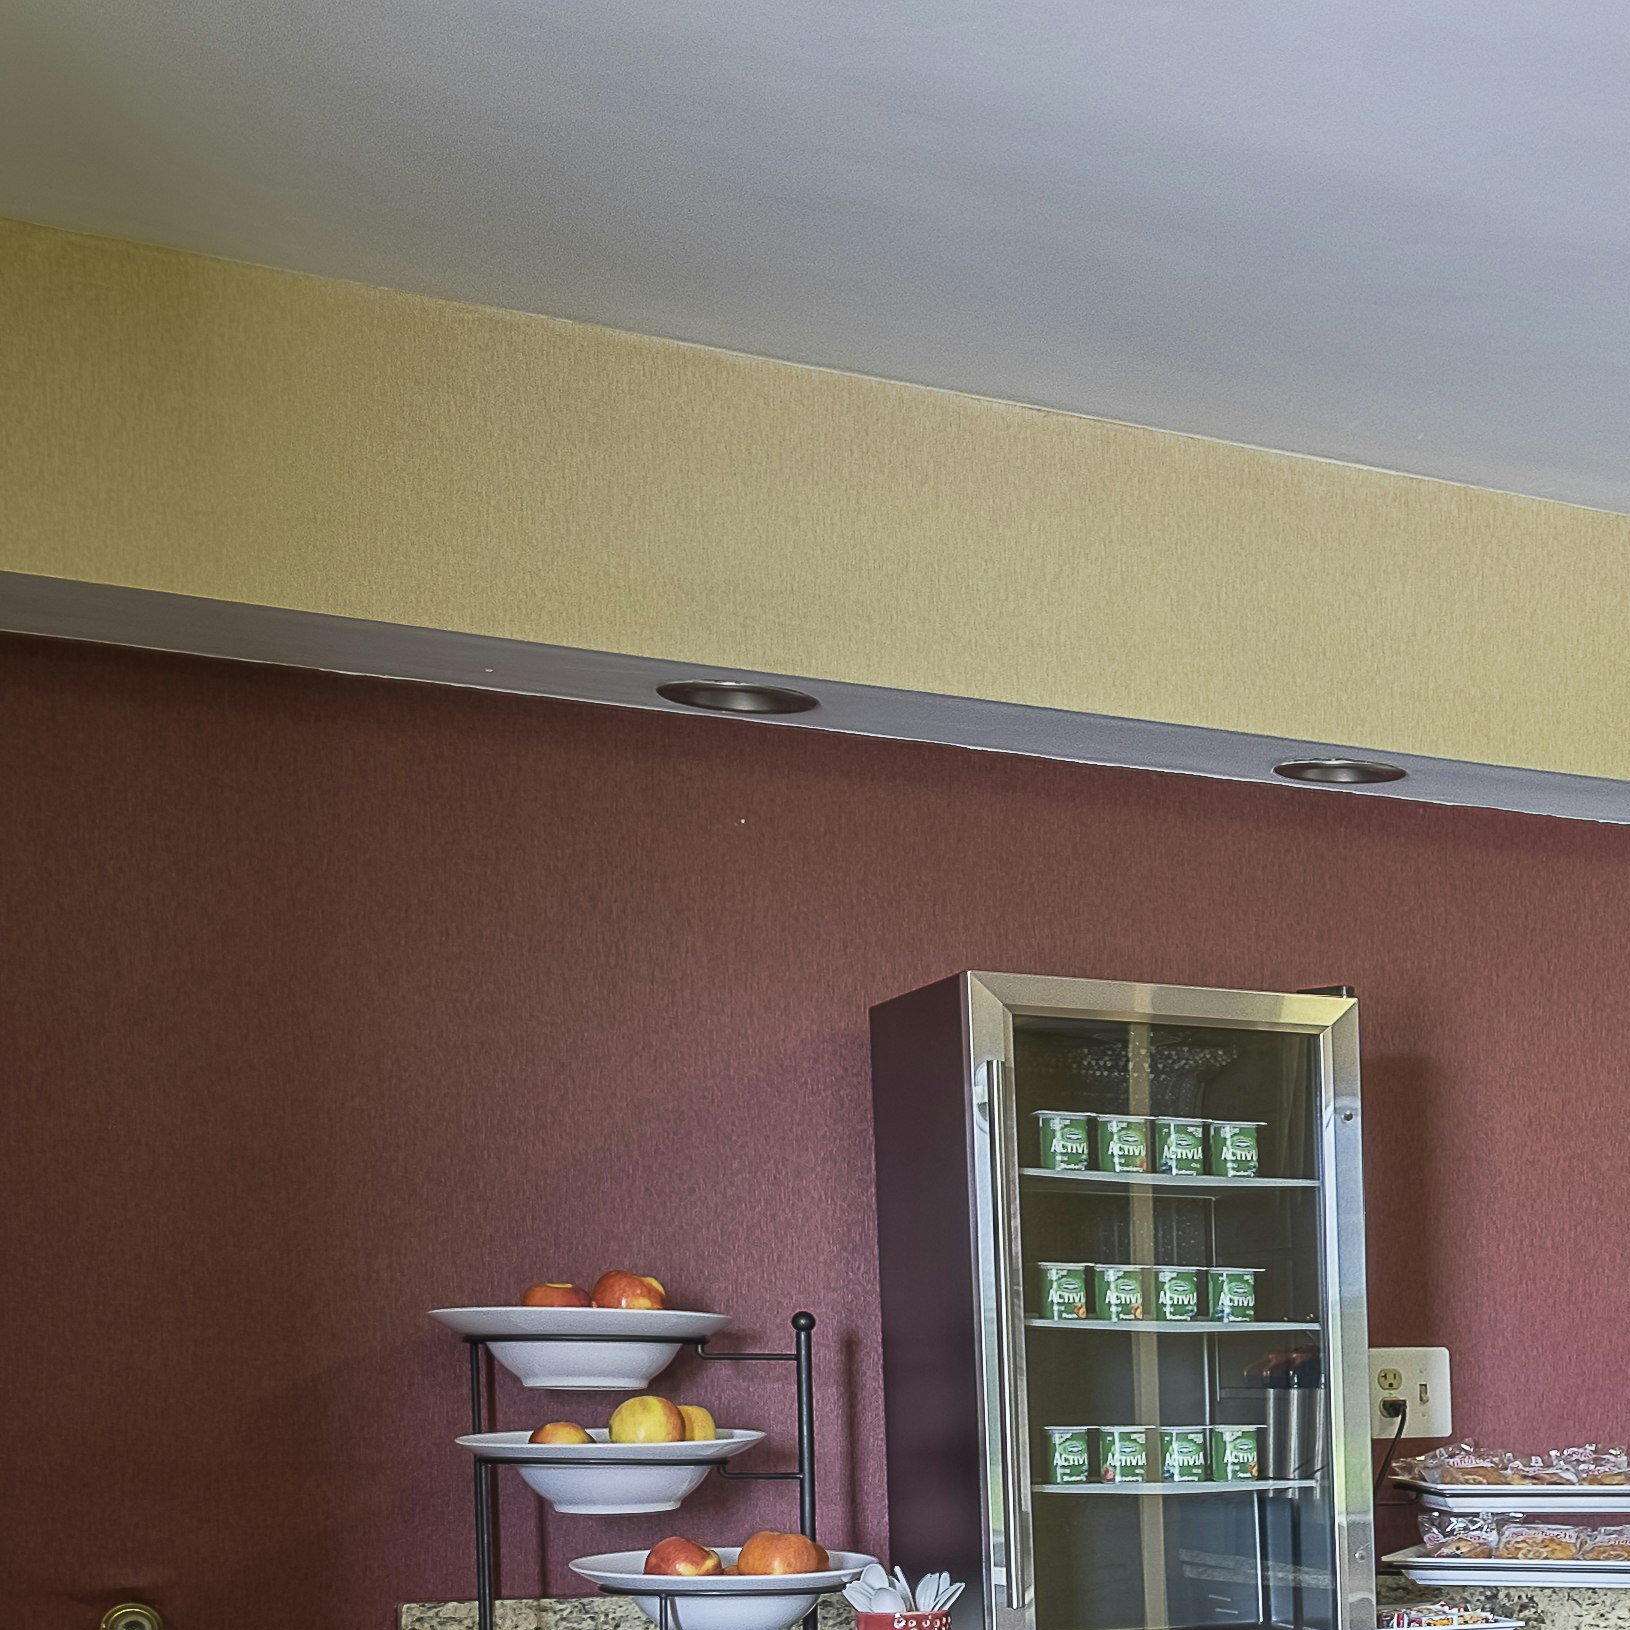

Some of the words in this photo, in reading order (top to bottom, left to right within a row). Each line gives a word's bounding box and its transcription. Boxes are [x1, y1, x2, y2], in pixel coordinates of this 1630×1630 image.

[1163, 1145, 1203, 1159] ACTIVIA
[1107, 1452, 1147, 1466] ACTIVIA
[1165, 1452, 1205, 1466] ACTIVIA
